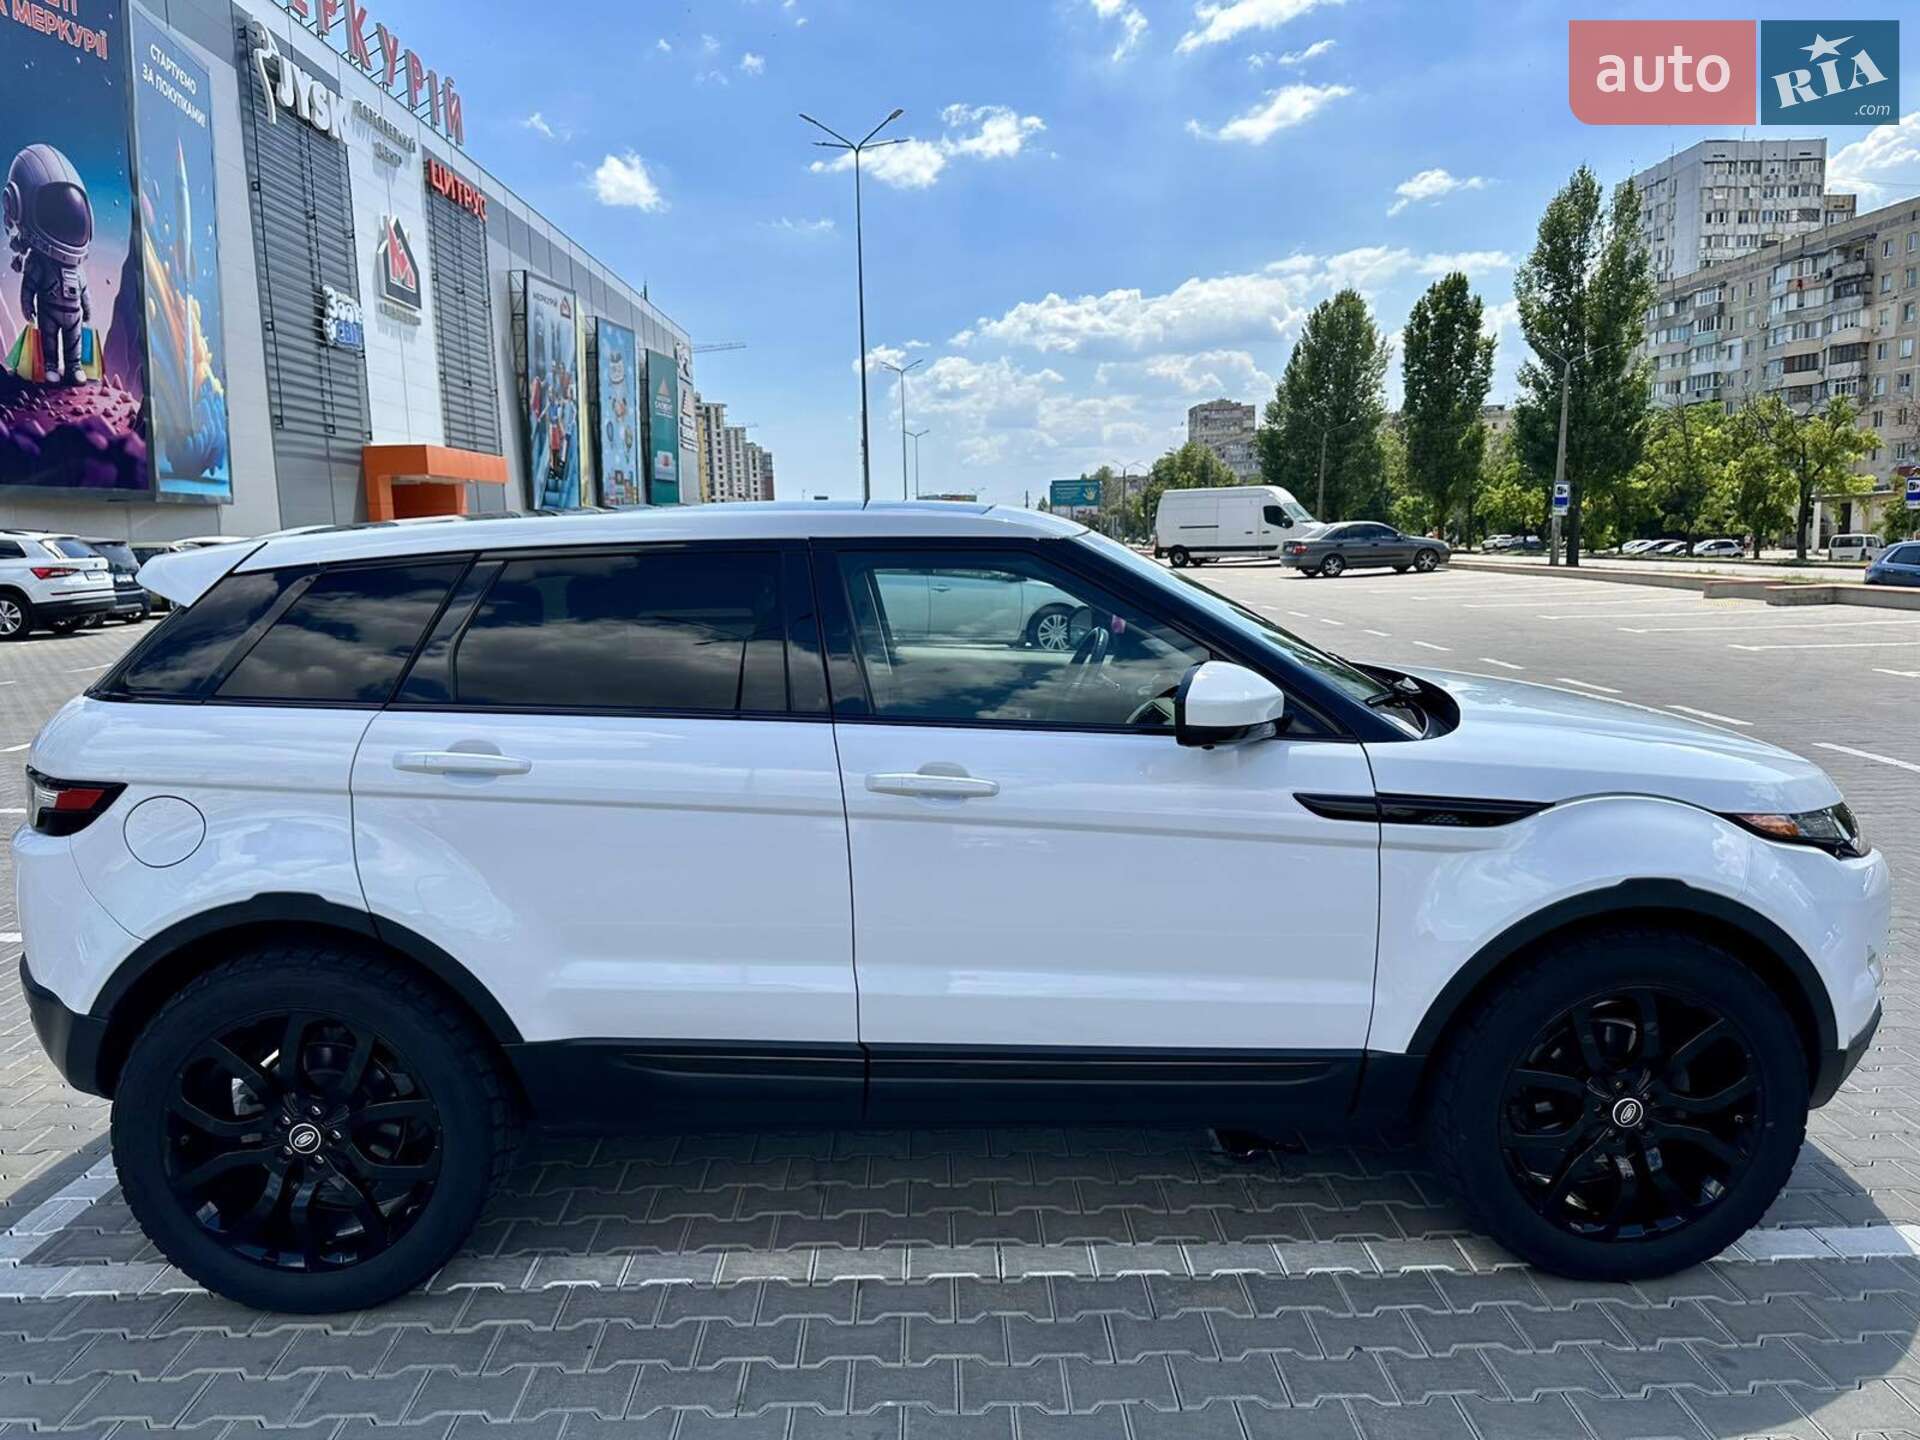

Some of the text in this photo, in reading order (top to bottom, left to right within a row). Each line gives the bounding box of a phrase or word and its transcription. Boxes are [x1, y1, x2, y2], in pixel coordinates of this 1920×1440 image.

[142, 63, 155, 85] ЗА
[150, 44, 197, 95] СТАРТУЄМО
[276, 54, 349, 144] JYSK
[287, 0, 464, 146] РКУРІЙ
[427, 158, 488, 222] ЦИТРУС
